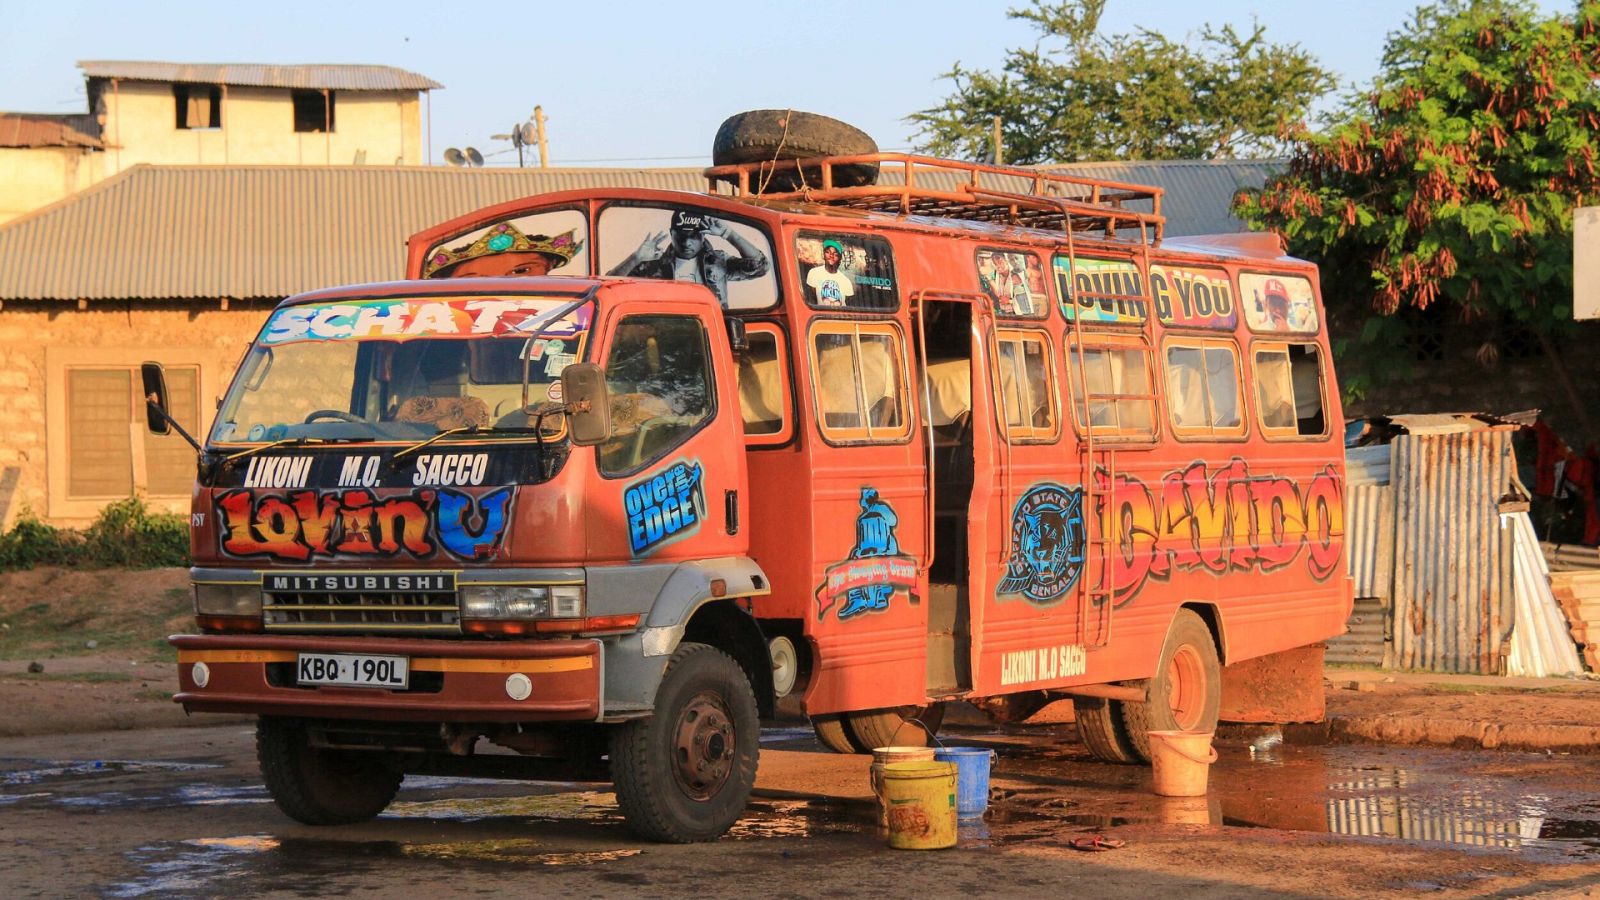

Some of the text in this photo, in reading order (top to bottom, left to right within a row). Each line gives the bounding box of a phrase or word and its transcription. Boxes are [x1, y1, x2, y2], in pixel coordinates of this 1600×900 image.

[855, 275, 892, 287] DAVIDO
[1175, 274, 1232, 319] YOU
[267, 300, 578, 337] SCHATZ
[244, 453, 489, 488] LIKONI M.O. SACCO
[630, 488, 695, 551] EDGE
[1095, 459, 1345, 605] DAVIDO
[273, 576, 446, 590] MITSUBISHI
[299, 657, 403, 684] KBQ 190L
[1001, 650, 1036, 686] LIKONI
[1059, 643, 1086, 678] SACCO
